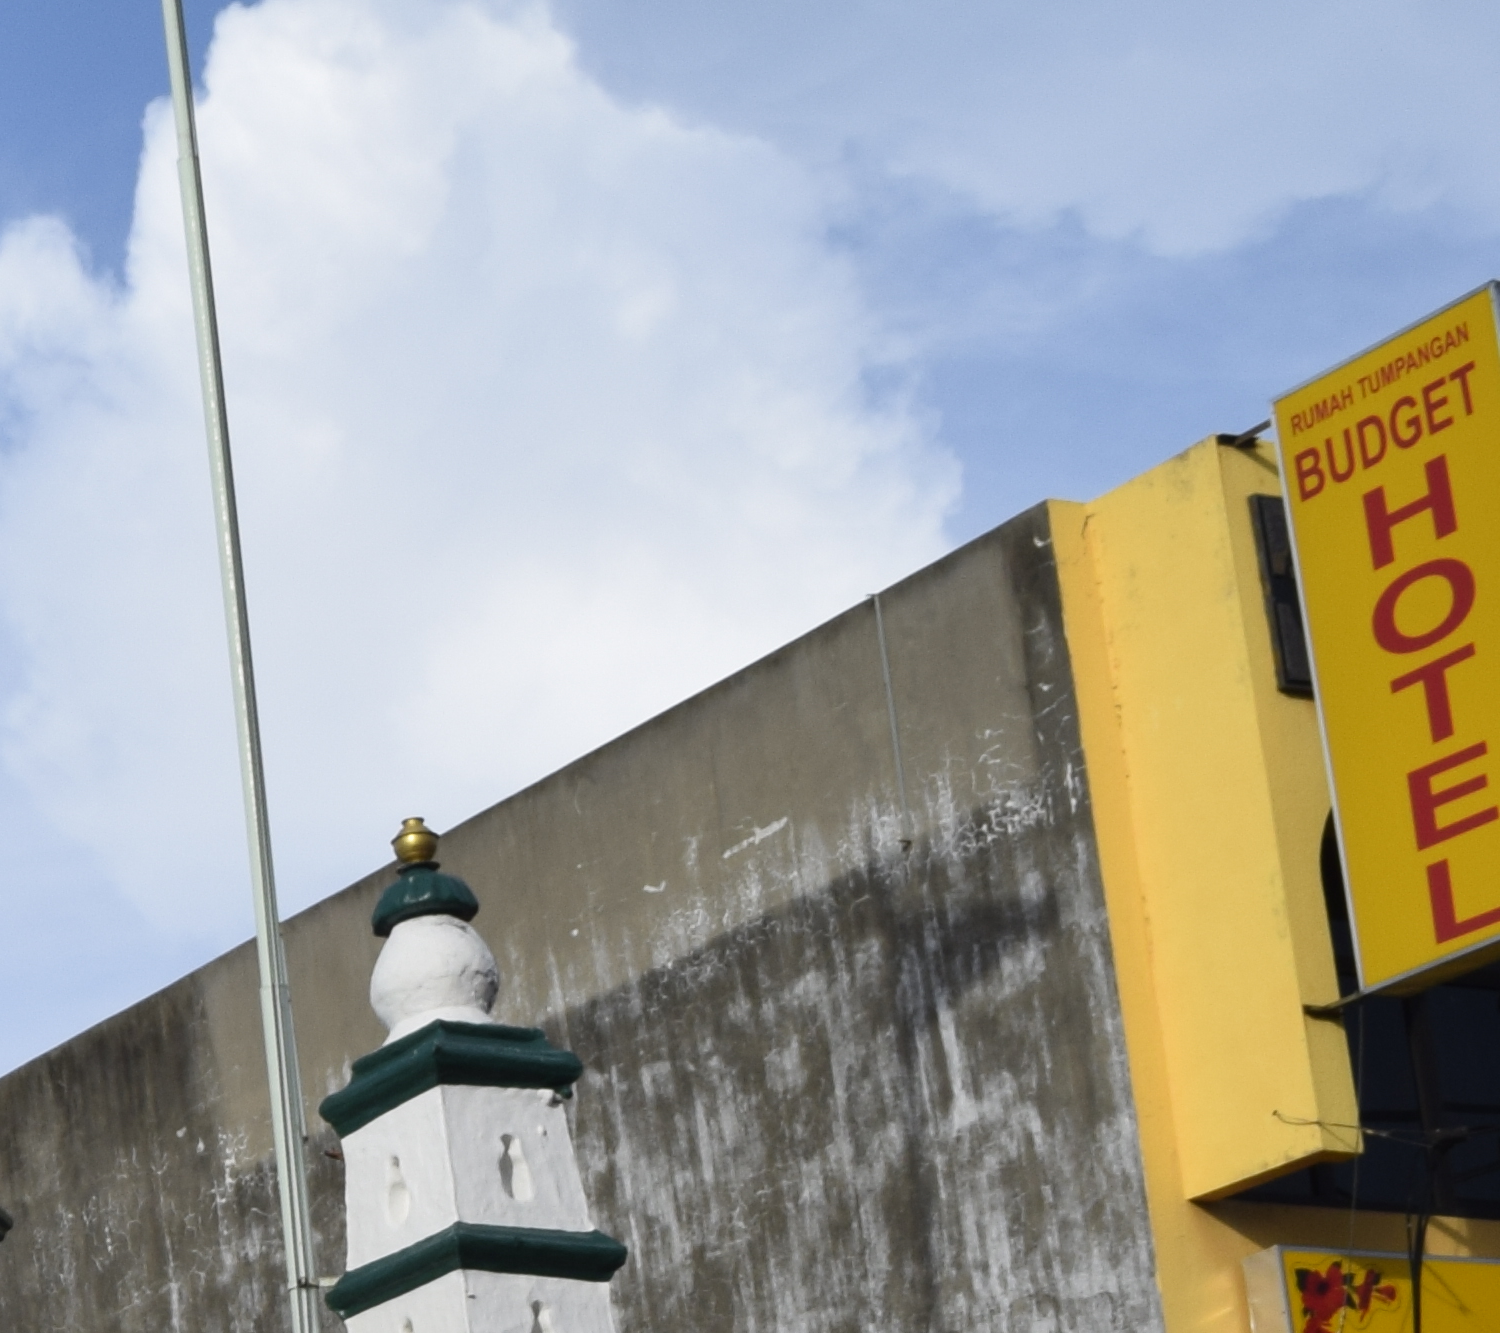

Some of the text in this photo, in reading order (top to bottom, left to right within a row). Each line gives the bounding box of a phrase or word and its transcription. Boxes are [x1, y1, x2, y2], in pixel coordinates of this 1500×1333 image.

[1290, 322, 1471, 438] RUMAH TUMPANGAN
[1294, 361, 1478, 503] BUDGET
[1362, 453, 1500, 945] HOTEL
